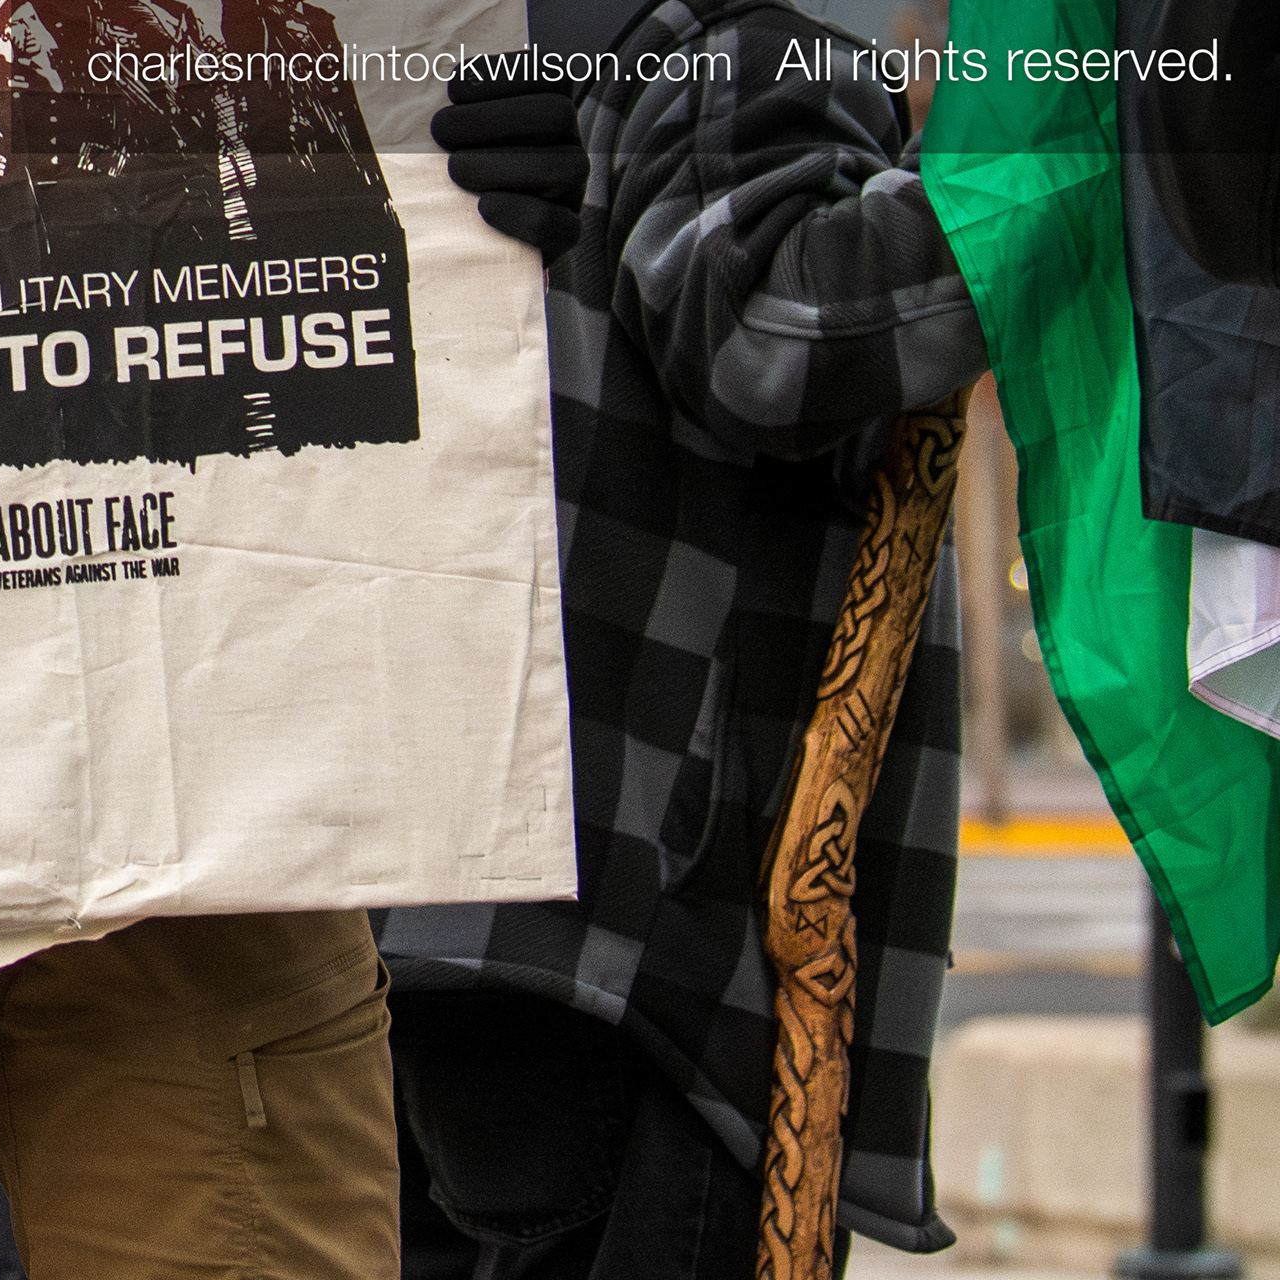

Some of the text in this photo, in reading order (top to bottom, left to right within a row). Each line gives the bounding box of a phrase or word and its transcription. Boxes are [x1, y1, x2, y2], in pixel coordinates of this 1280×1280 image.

[115, 308, 394, 384] REFUSE
[105, 491, 177, 552] FACE
[65, 562, 117, 584] AGAINST
[122, 560, 147, 579] THE
[151, 557, 180, 577] WAR
